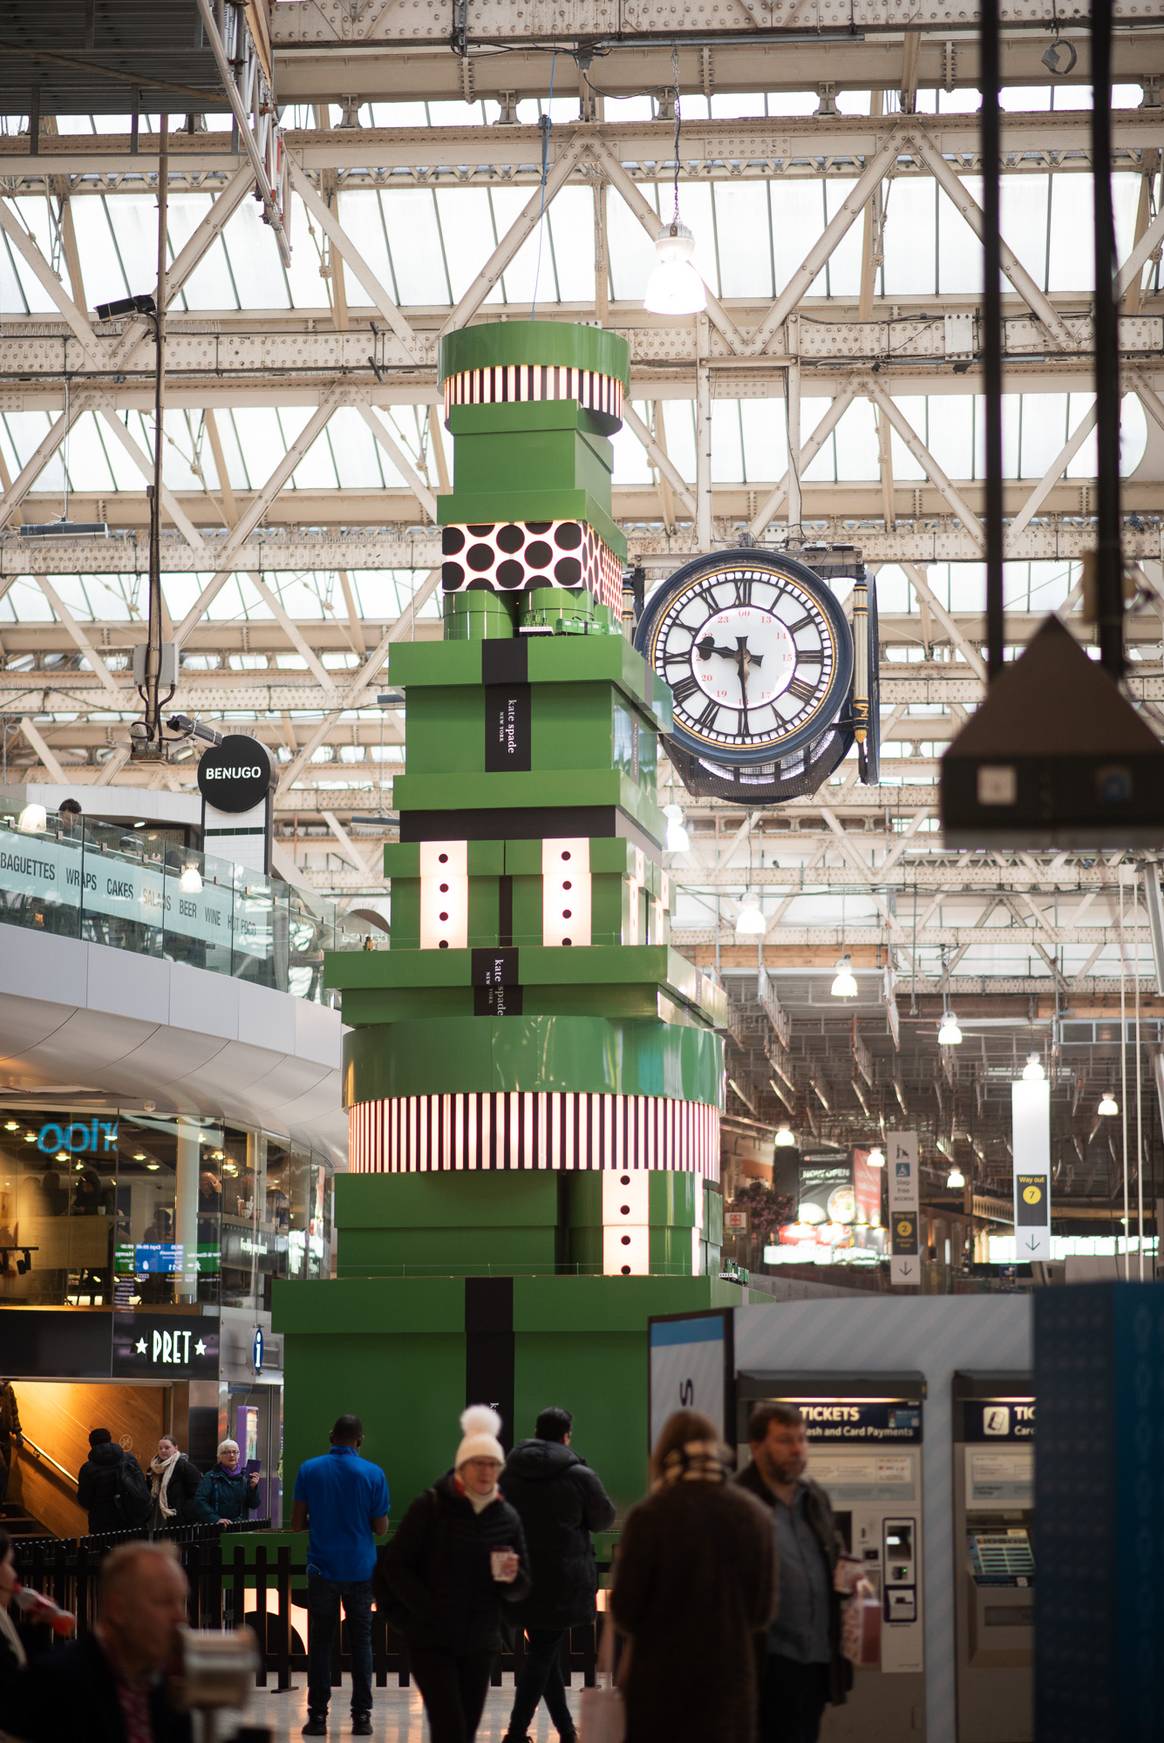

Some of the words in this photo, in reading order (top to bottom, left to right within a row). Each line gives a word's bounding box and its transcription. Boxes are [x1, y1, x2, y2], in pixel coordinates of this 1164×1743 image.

[717, 616, 729, 624] 23
[760, 616, 772, 624] 13
[776, 632, 787, 640] 14
[701, 674, 712, 682] 20
[507, 699, 517, 722] kate
[505, 724, 517, 754] spade
[206, 766, 262, 780] BENUGO
[0, 852, 55, 881] BAGUETTES
[65, 867, 97, 890] WRAPS
[106, 878, 134, 900] CAKES
[179, 899, 197, 919] BEER
[205, 907, 221, 926] WINE
[494, 959, 504, 982] kate
[495, 986, 507, 1016] spade
[1018, 1176, 1033, 1184] Way
[1029, 1190, 1035, 1199] 7
[152, 1329, 192, 1364] PRET
[799, 1406, 860, 1421] TICKETS
[824, 1426, 842, 1436] and
[843, 1426, 865, 1437] Card
[867, 1426, 913, 1438] Payments
